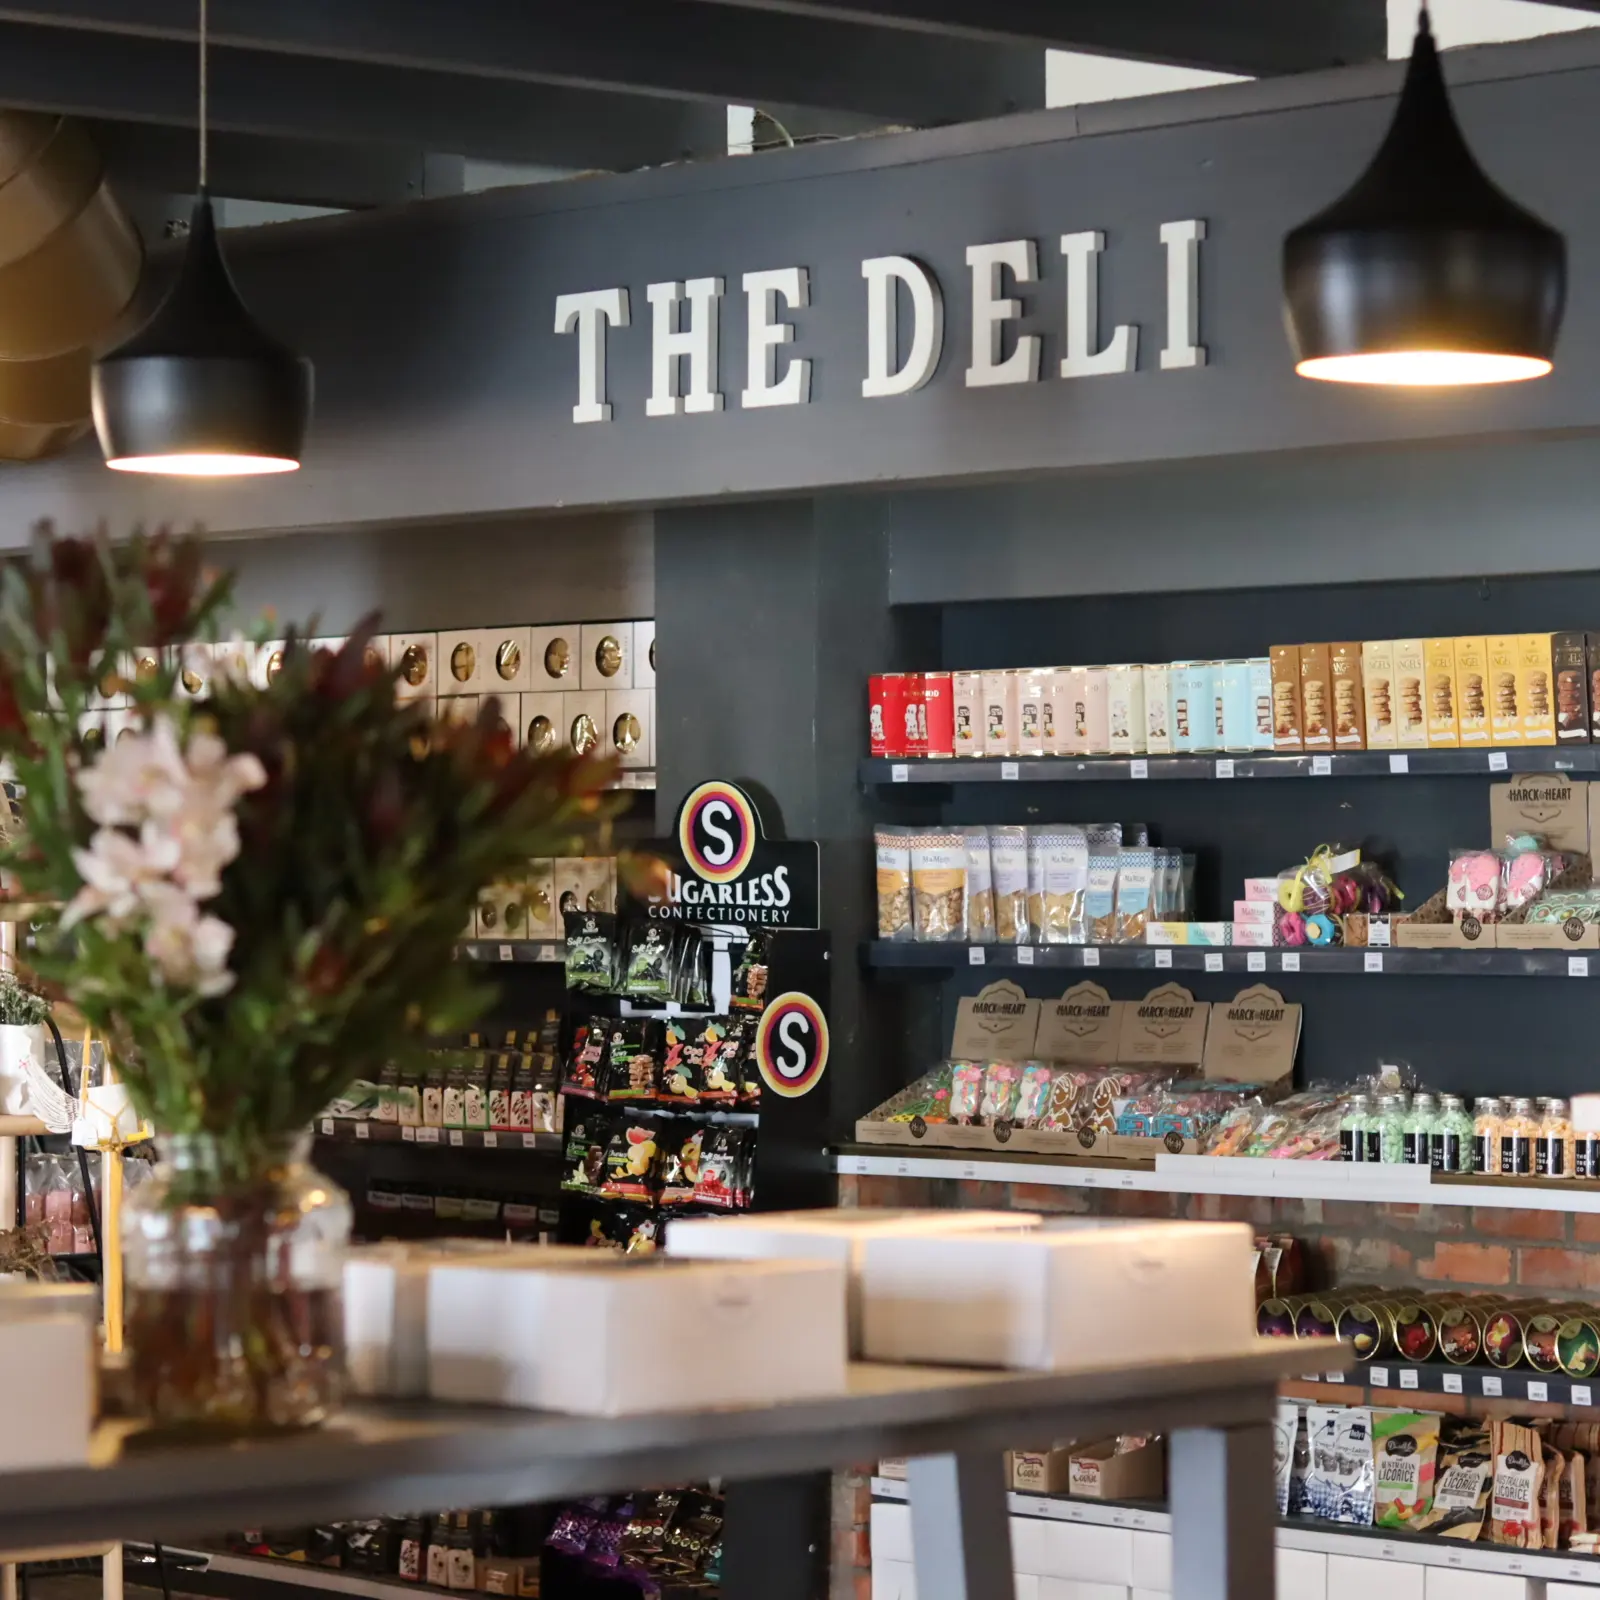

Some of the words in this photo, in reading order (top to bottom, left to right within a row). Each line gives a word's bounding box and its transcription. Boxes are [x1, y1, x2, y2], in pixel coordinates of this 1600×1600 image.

[555, 267, 810, 425] THE
[862, 219, 1206, 397] DELI
[1508, 788, 1539, 802] HARCK
[1544, 787, 1571, 800] HEART
[701, 800, 734, 865] S
[648, 865, 791, 908] UGARLESS
[648, 905, 790, 923] CONFECTIONERY
[972, 1002, 998, 1014] HARCK
[1001, 1003, 1026, 1015] HEART
[1056, 1005, 1082, 1016] HARCK
[1087, 1005, 1111, 1017] HEART
[1138, 1006, 1164, 1018] HARCK
[1168, 1006, 1194, 1018] HEART
[1228, 1008, 1255, 1020] HARCK
[1259, 1009, 1285, 1021] HEART
[776, 1011, 810, 1078] S
[1378, 1468, 1415, 1483] LICORICE
[1443, 1477, 1479, 1491] LICORICE
[1495, 1484, 1529, 1501] LICORICE
